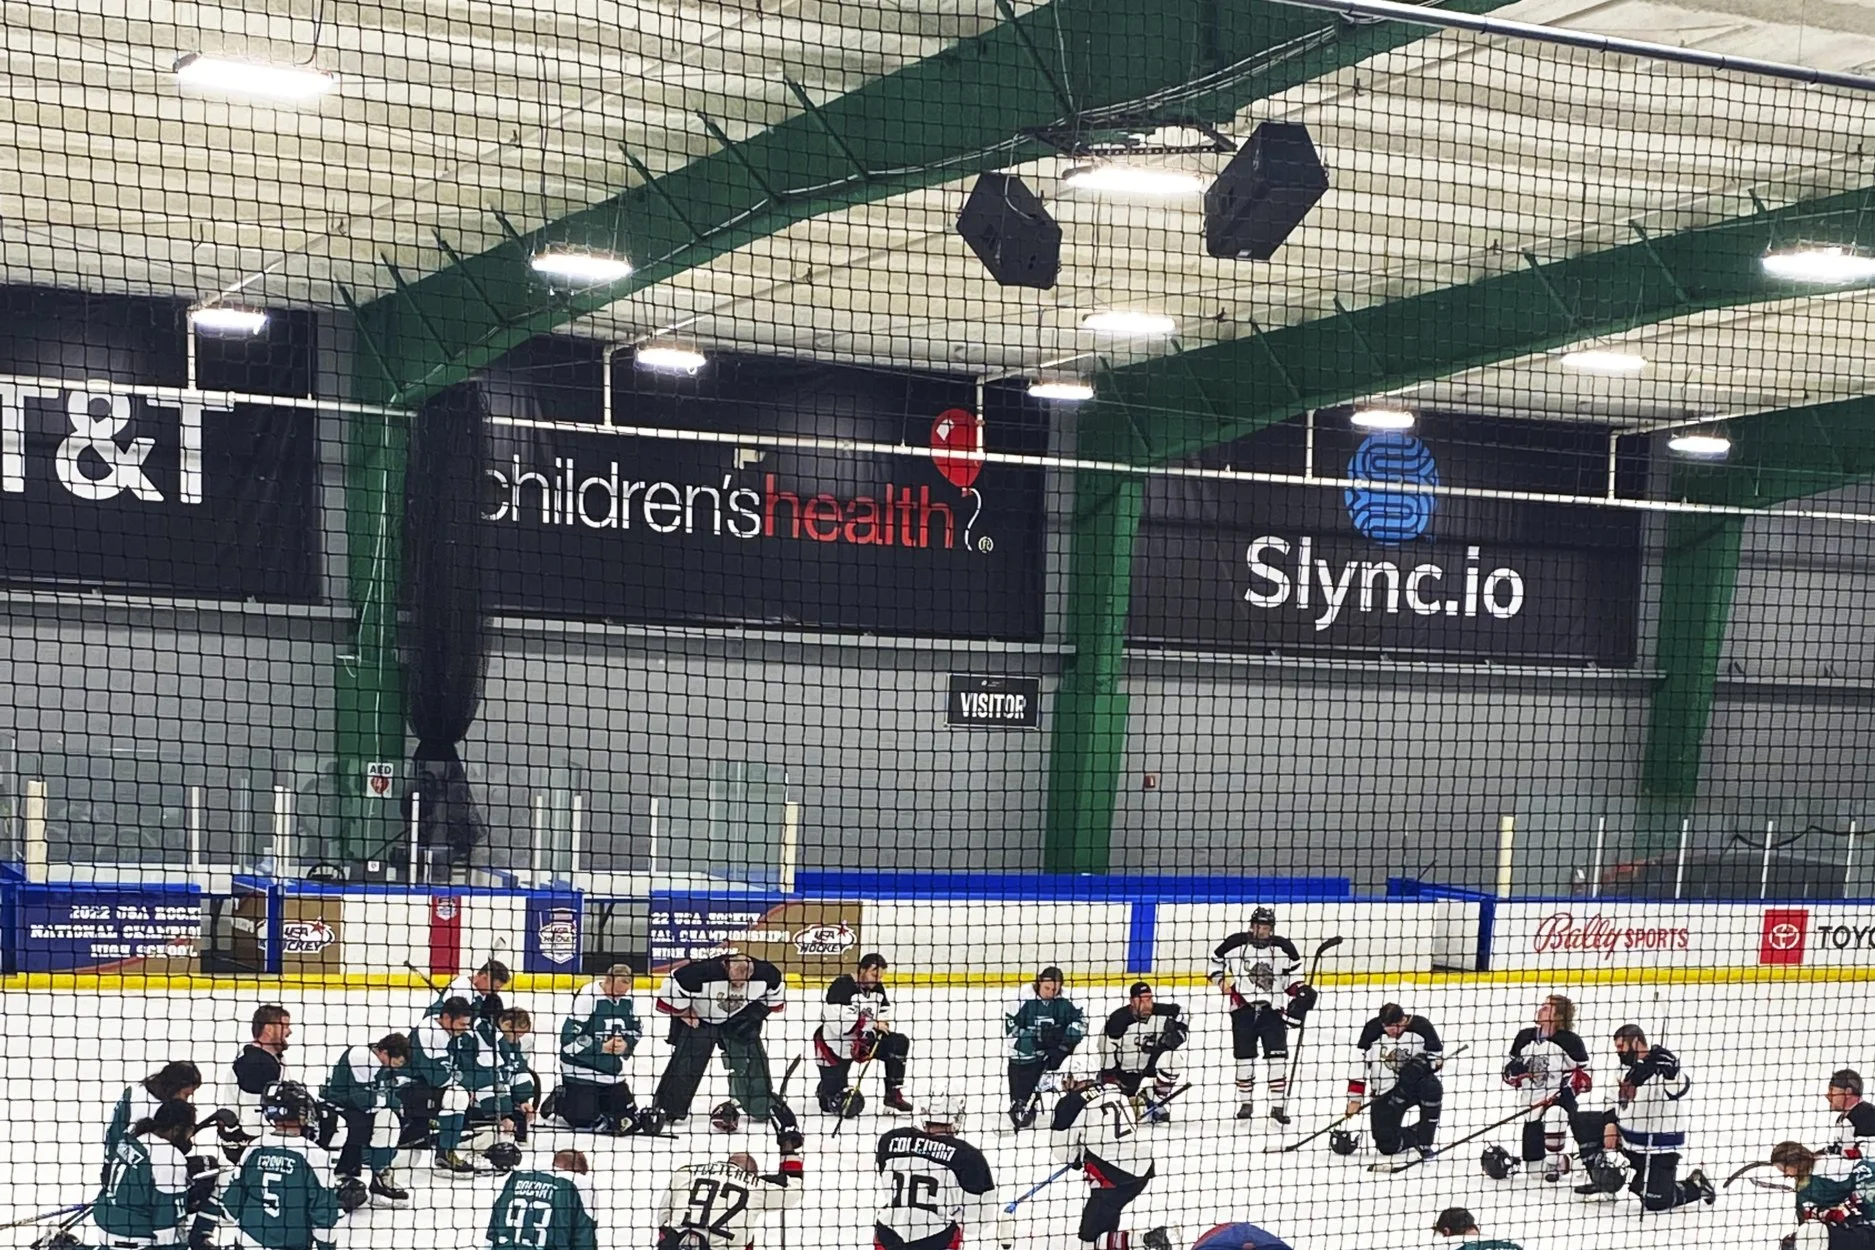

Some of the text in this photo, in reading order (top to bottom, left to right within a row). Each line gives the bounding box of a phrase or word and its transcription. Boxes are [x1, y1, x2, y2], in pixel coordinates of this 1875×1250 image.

[1243, 535, 1524, 632] Slync.io
[960, 692, 1026, 719] VISITOR
[370, 765, 392, 775] AED
[116, 906, 150, 919] USA
[30, 924, 118, 938] NATIONAL
[1534, 912, 1688, 960] Bally SPORTS
[90, 944, 198, 958] HIGH SCHOOL
[800, 943, 846, 953] HOCKEY
[261, 1172, 282, 1218] 5
[681, 1177, 750, 1241] 92
[498, 1198, 553, 1250] 93
